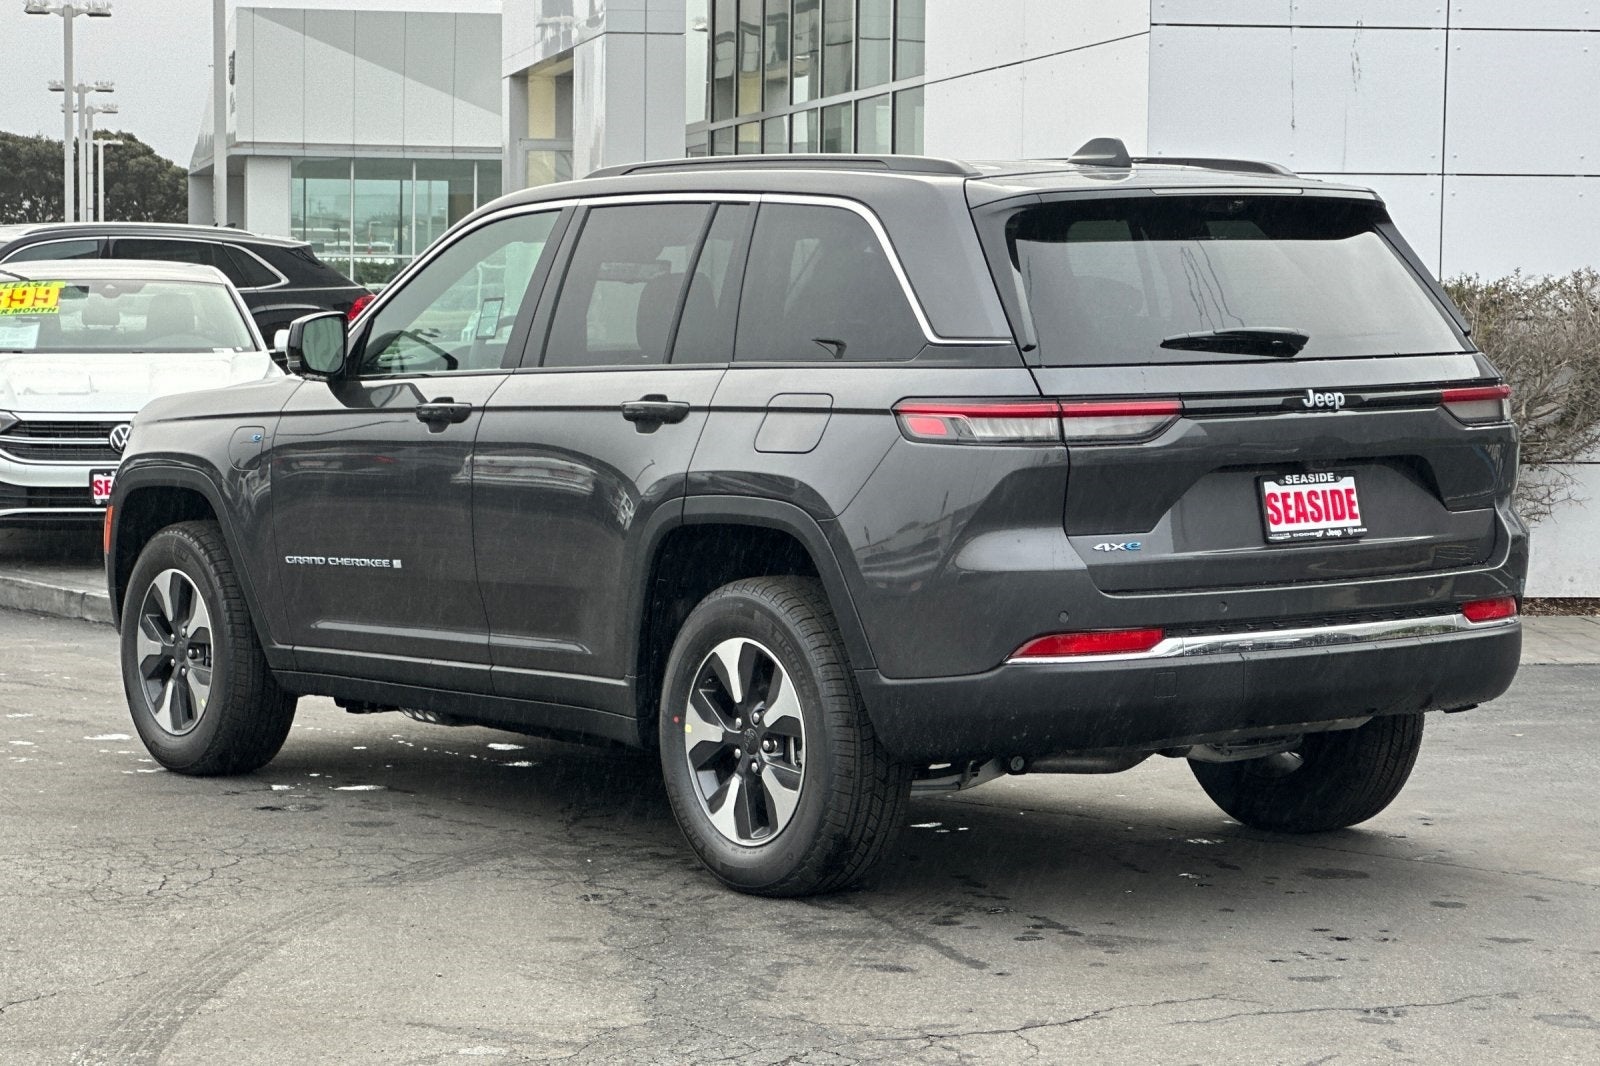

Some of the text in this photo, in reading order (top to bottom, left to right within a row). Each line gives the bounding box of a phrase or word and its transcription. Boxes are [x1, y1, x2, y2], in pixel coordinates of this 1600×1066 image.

[11, 307, 57, 315] MONTH
[1302, 389, 1346, 410] Jeep
[1284, 472, 1335, 485] SEASIDE
[92, 479, 113, 497] SE
[1265, 488, 1359, 526] SEASIDE
[284, 555, 391, 568] GRAND CHEROKEE
